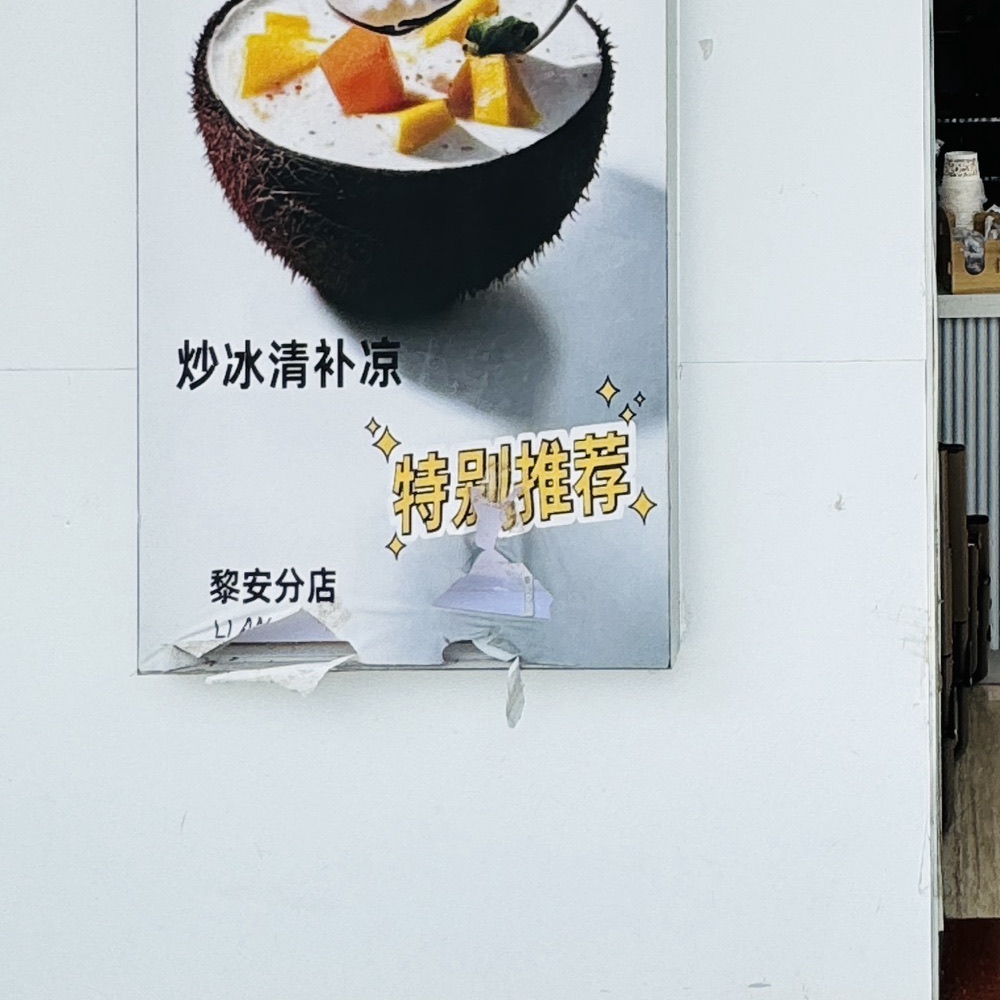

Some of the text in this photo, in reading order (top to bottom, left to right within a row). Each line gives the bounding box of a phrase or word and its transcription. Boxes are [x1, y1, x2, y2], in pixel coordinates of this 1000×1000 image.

[176, 337, 401, 390] 炒冰清补凉
[392, 430, 632, 536] 特别推荐
[210, 567, 336, 604] 黎安分店
